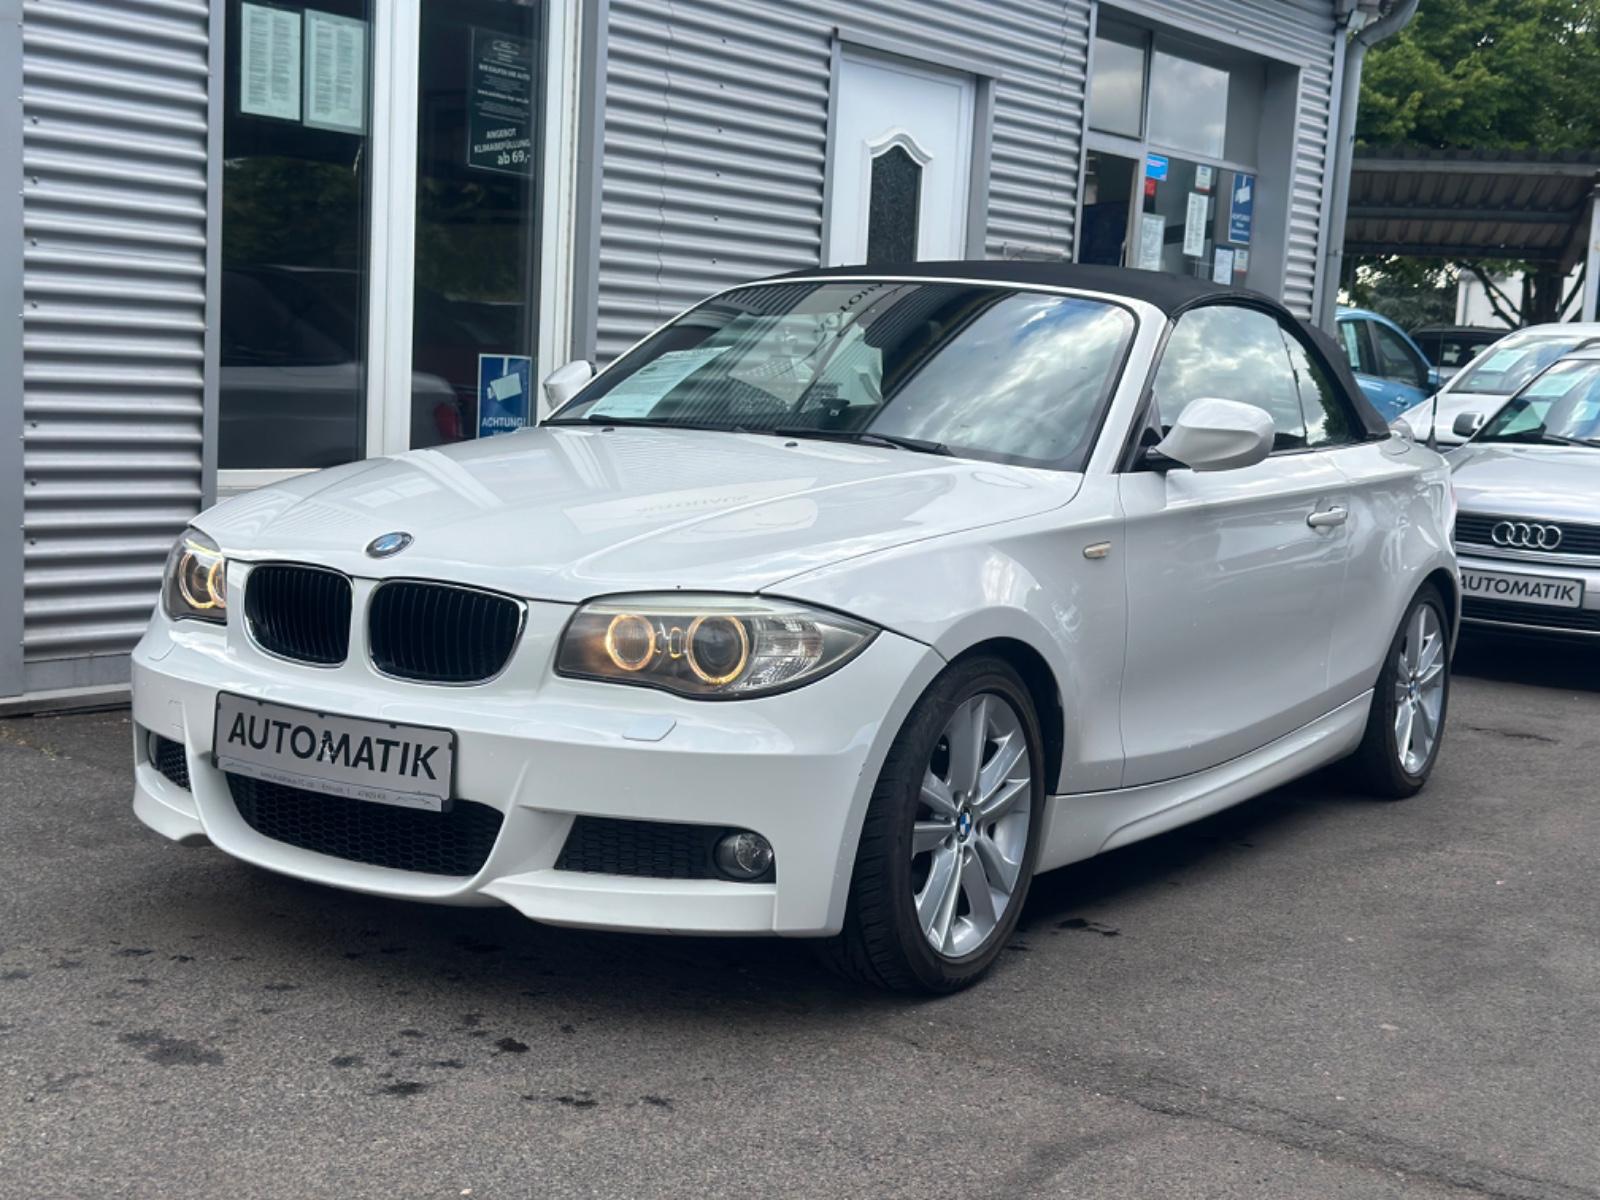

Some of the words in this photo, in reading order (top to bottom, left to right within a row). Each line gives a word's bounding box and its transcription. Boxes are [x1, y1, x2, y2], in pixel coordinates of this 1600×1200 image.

[486, 128, 516, 139] ANGEBOT
[498, 150, 510, 165] ab
[512, 150, 531, 164] 69,-
[481, 417, 527, 428] ACHTUNG!
[1461, 575, 1575, 601] AUTOMATIK
[227, 712, 439, 781] AUTOMATIK
